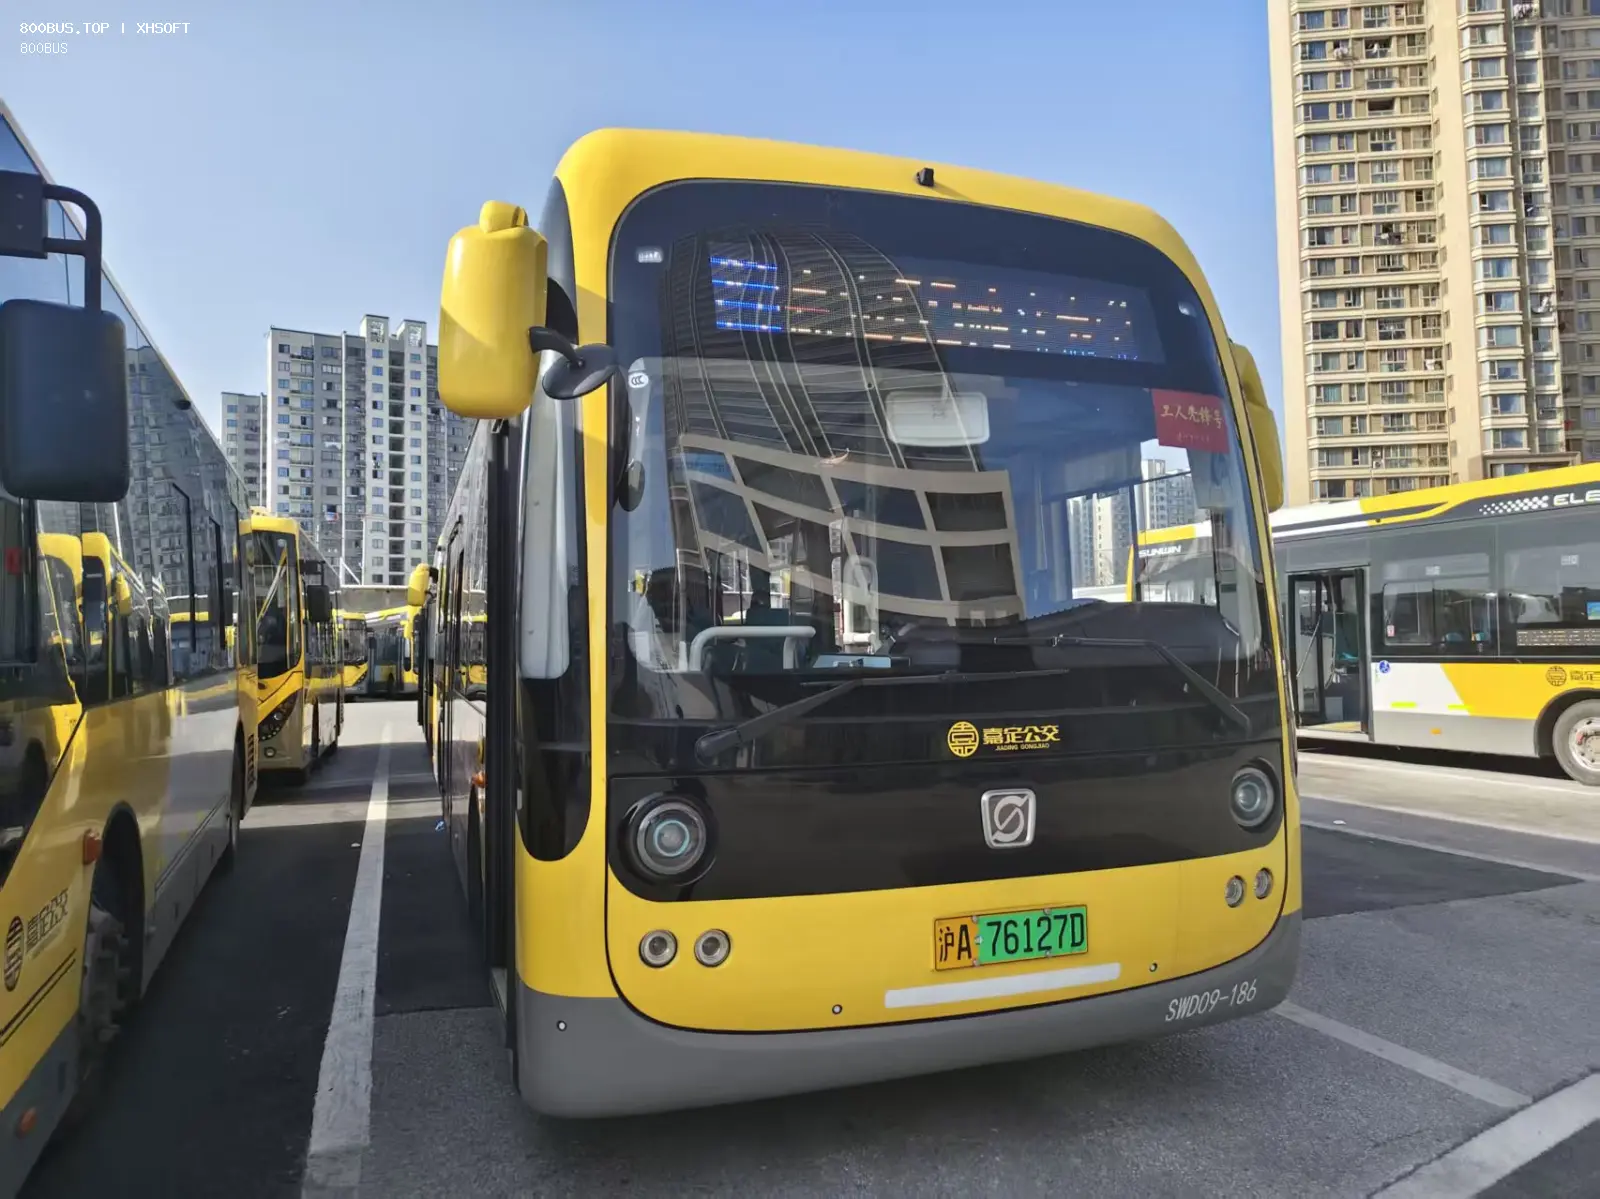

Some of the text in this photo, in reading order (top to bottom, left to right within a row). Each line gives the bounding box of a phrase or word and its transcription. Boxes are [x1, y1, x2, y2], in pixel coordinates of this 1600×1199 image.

[982, 724, 1061, 745] 嘉定公交
[938, 912, 1086, 963] 沪A 76127D
[1164, 978, 1258, 1022] SWD09-186
